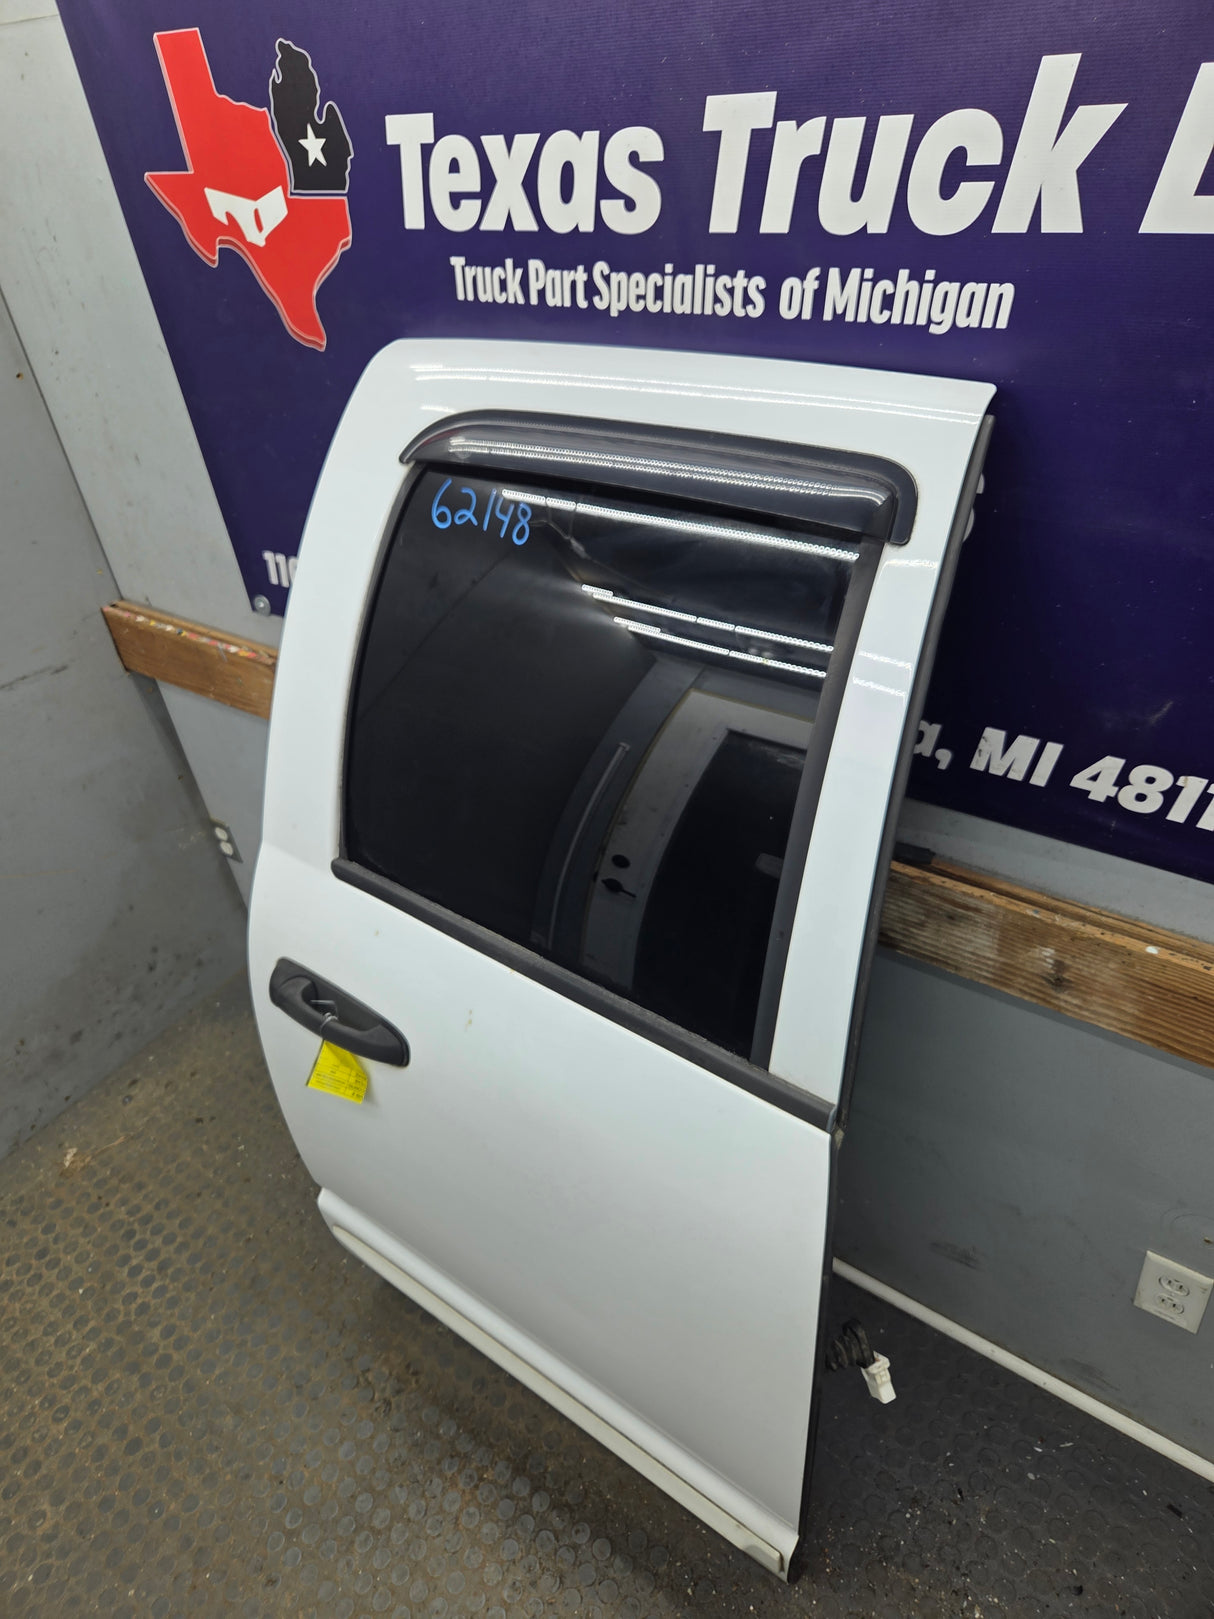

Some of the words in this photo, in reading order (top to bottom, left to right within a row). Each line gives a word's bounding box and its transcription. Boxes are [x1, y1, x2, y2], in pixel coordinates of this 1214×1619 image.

[385, 112, 665, 235] Texas
[703, 53, 1129, 236] Truck
[450, 256, 525, 304] Truck
[527, 258, 589, 309] Part
[592, 260, 767, 318] Specialists
[778, 267, 821, 320] of
[822, 267, 1015, 335] Michigan
[431, 478, 532, 545] 62148
[969, 726, 1064, 787] MI
